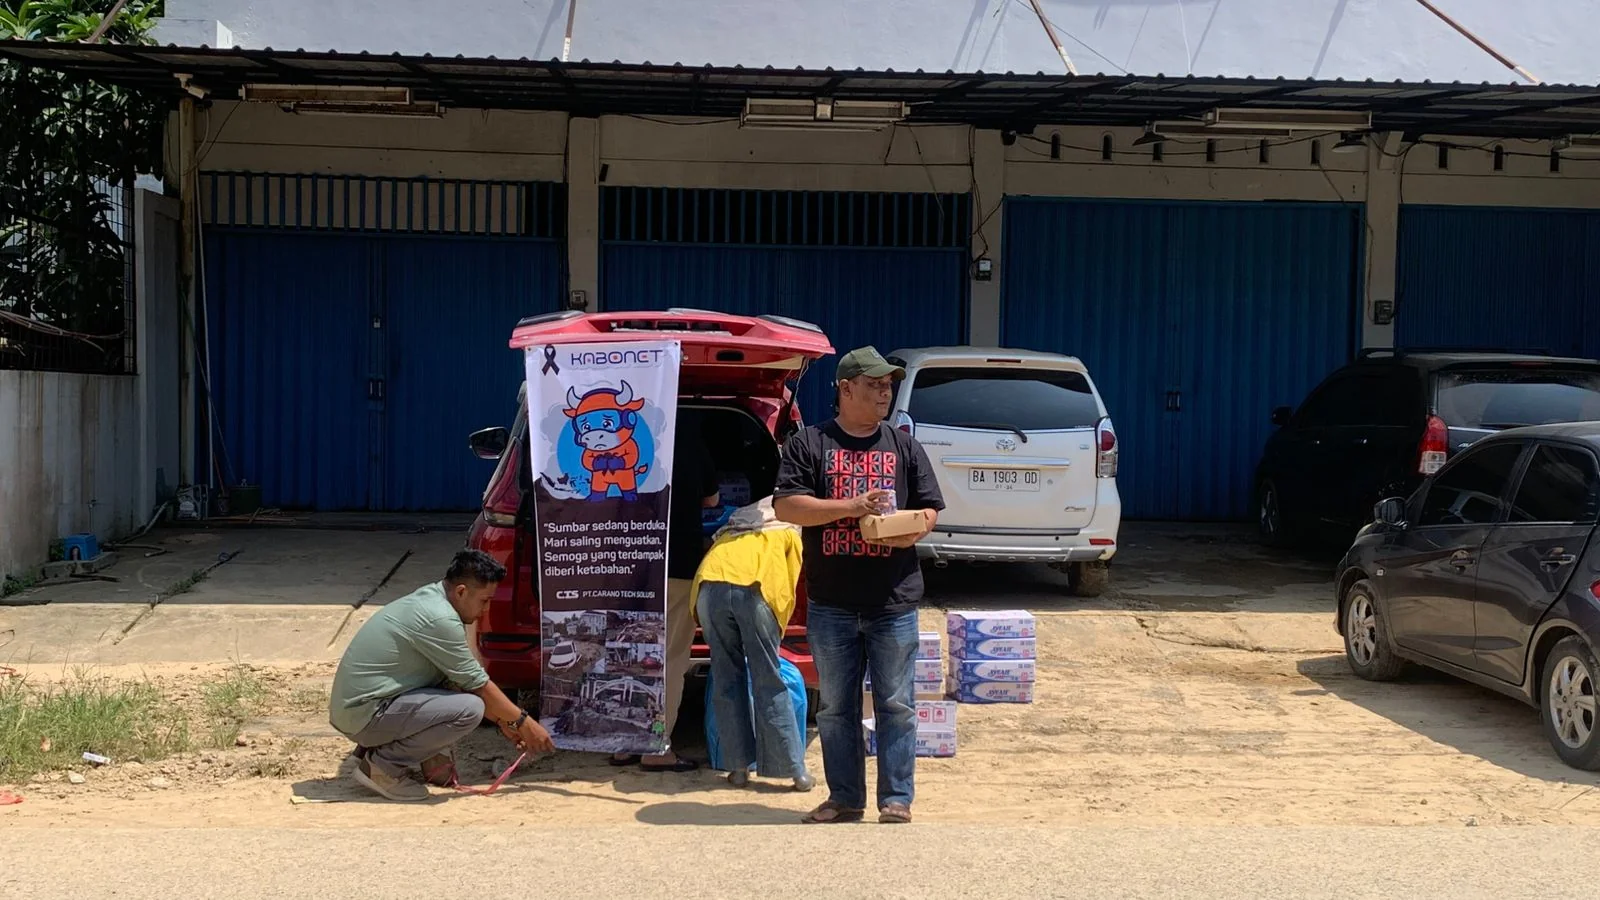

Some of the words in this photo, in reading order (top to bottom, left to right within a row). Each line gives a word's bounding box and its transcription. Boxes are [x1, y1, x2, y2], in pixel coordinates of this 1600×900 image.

[571, 350, 663, 365] KABONET
[972, 470, 985, 483] BA
[993, 471, 1017, 484] 1903
[592, 520, 629, 533] sedang
[544, 537, 567, 548] Mari
[569, 536, 601, 548] saling
[603, 535, 662, 547] menguatkan.
[544, 551, 588, 563] Semoga
[590, 551, 616, 563] yang
[617, 550, 664, 562] terdampak
[545, 566, 575, 577] diberi
